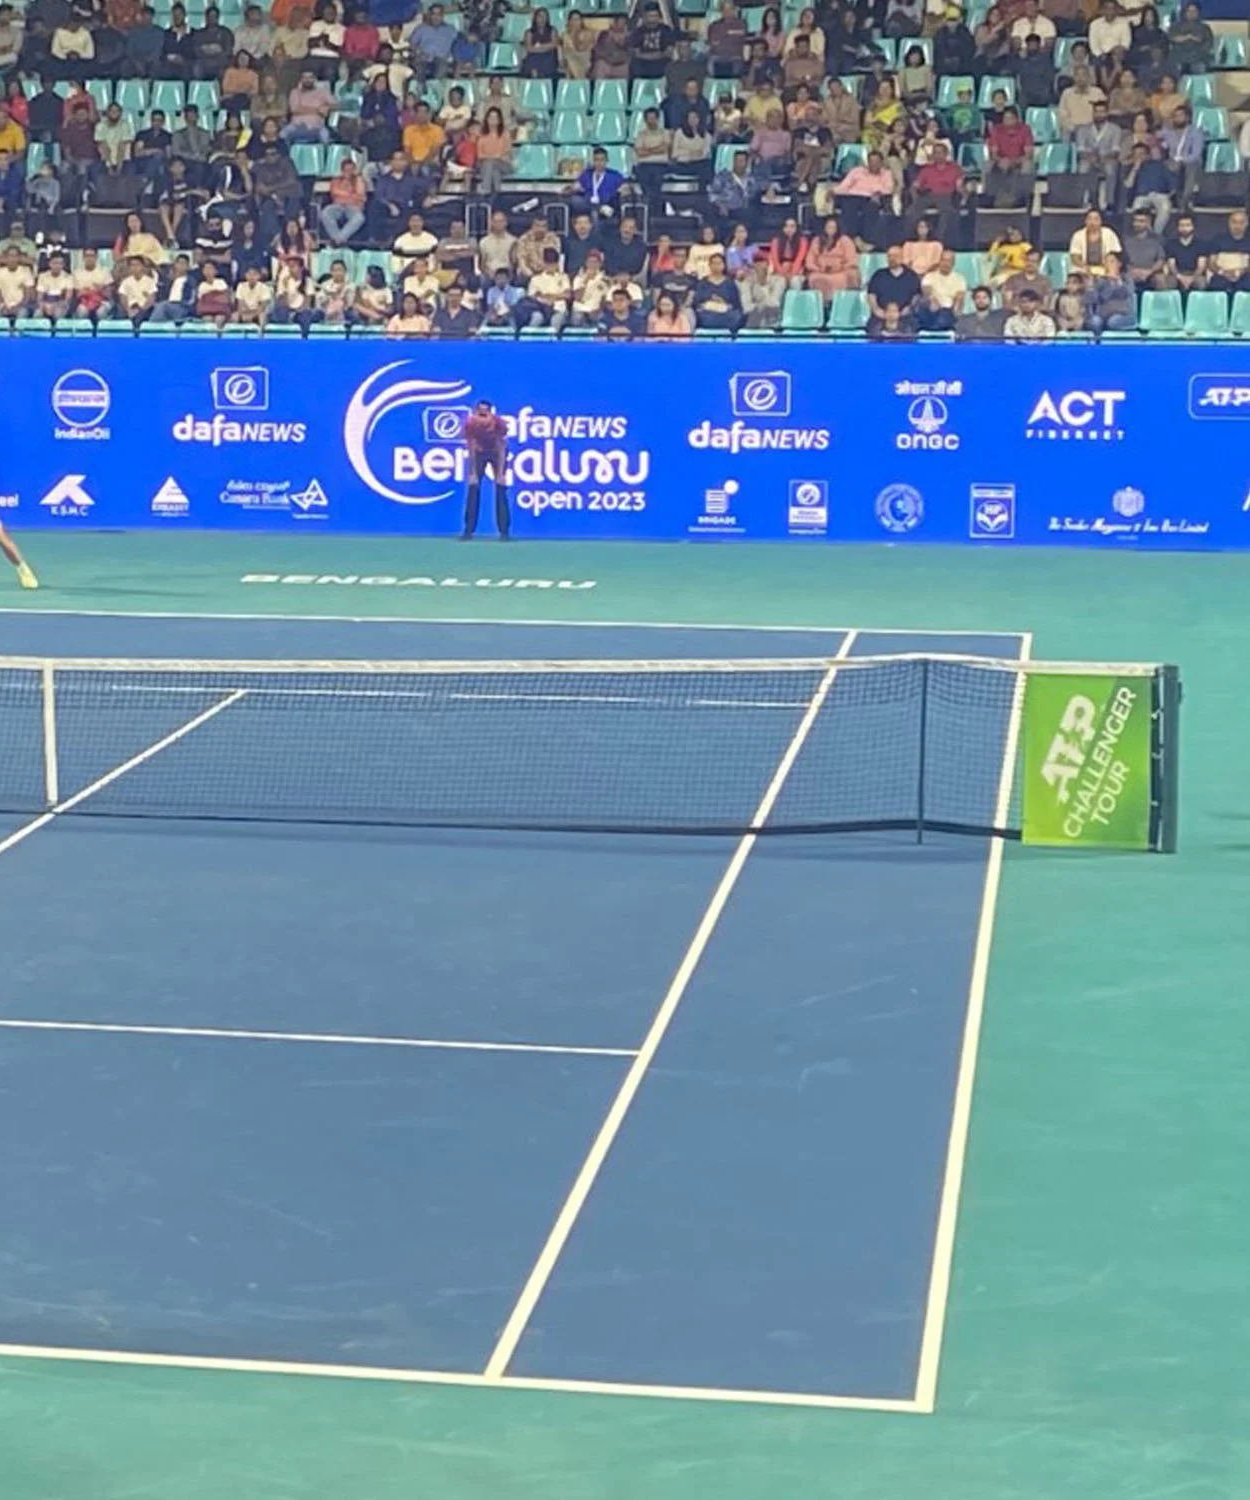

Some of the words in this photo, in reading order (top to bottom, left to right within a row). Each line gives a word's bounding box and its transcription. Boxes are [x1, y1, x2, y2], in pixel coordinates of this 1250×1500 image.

[1027, 390, 1126, 426] ACT
[172, 413, 307, 446] dafaNEWS
[688, 420, 830, 453] dafaNEWS
[517, 488, 582, 516] open
[588, 491, 645, 512] 2023
[240, 573, 597, 589] BENGALURU
[1041, 694, 1097, 806] ATP
[1062, 686, 1138, 839] CHALLENGER
[1090, 760, 1131, 825] TOUR
